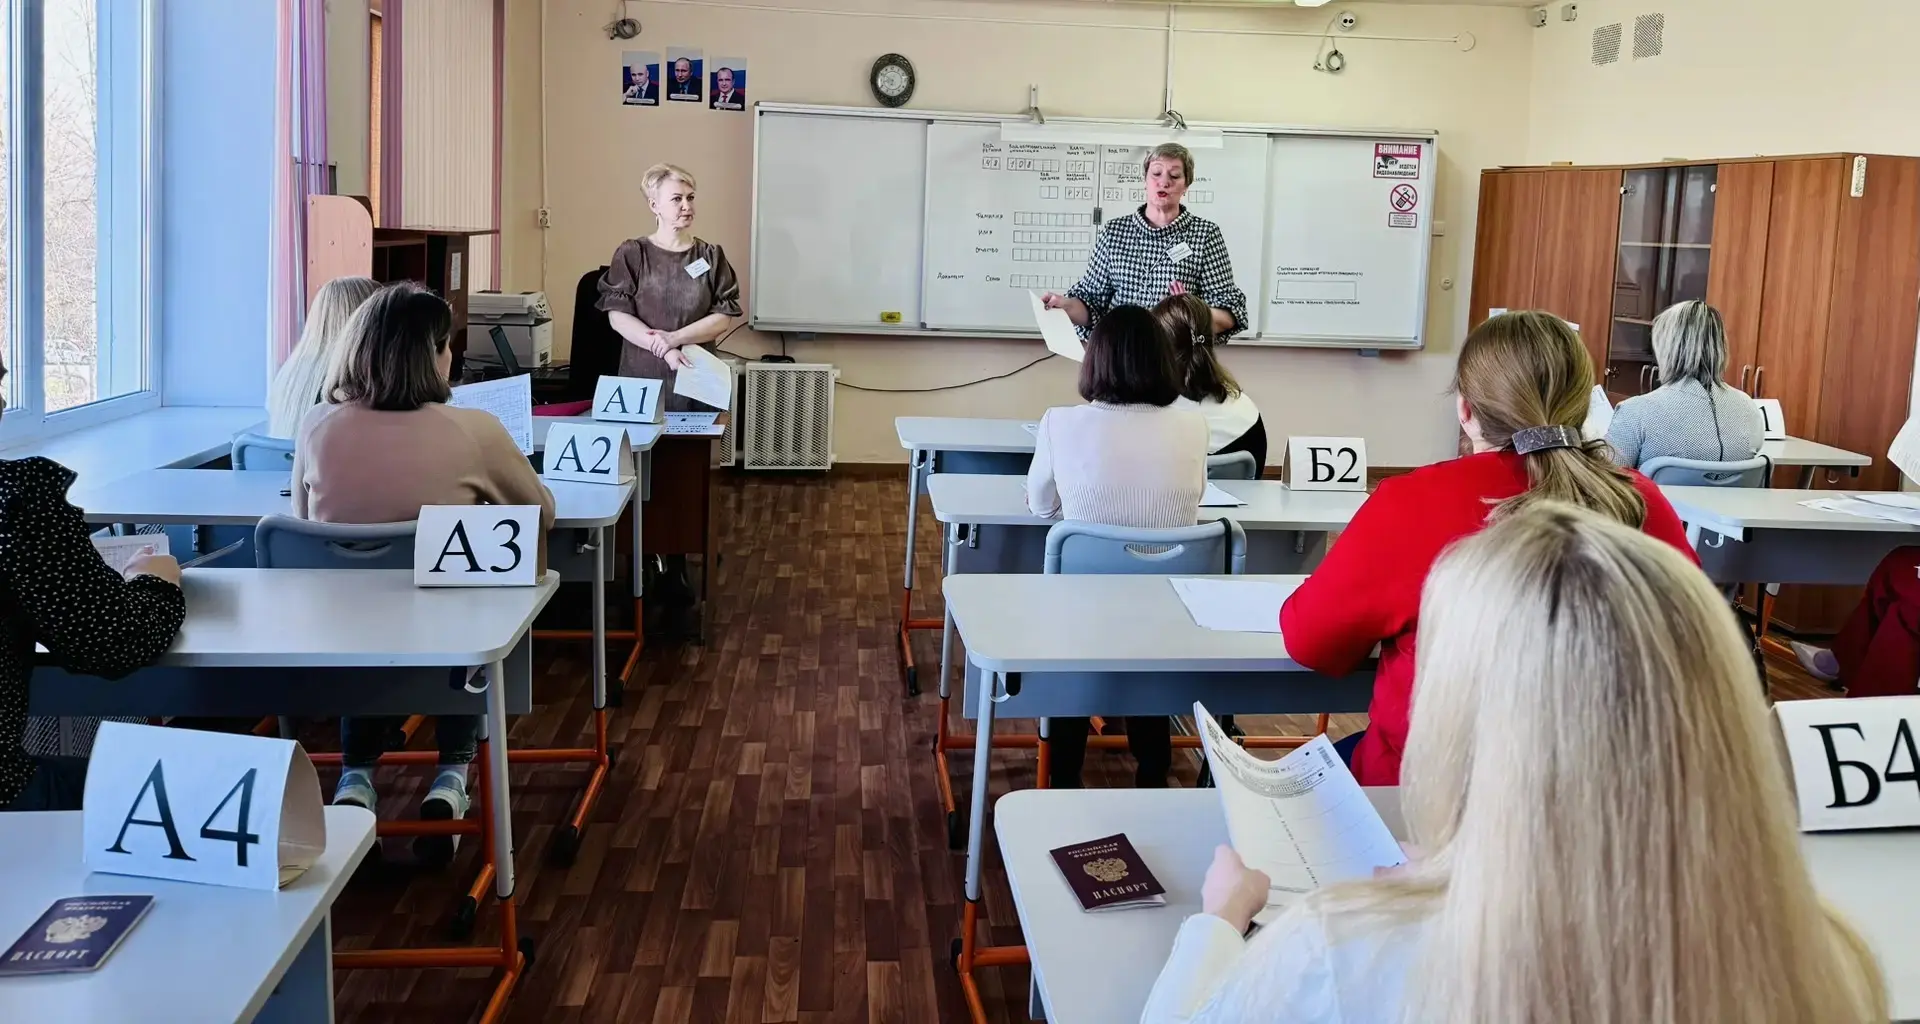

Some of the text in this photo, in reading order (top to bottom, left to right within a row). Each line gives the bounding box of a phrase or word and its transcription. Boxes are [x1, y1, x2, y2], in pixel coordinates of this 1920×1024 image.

[1378, 144, 1418, 155] ВНИМАНИЕ
[1067, 189, 1089, 197] РУС
[601, 384, 648, 414] А1
[1759, 406, 1772, 432] 1
[552, 434, 612, 475] А2
[1306, 447, 1360, 482] Б2
[429, 518, 522, 573] А3
[1809, 718, 1920, 808] Б4
[104, 757, 260, 867] А4
[1067, 842, 1118, 855] РОССИЙСКАЯ
[1073, 847, 1118, 858] ФЕДЕРАЦИЯ
[1092, 882, 1149, 900] ПАСПОРТ
[10, 949, 89, 962] ПАСПОРТ
